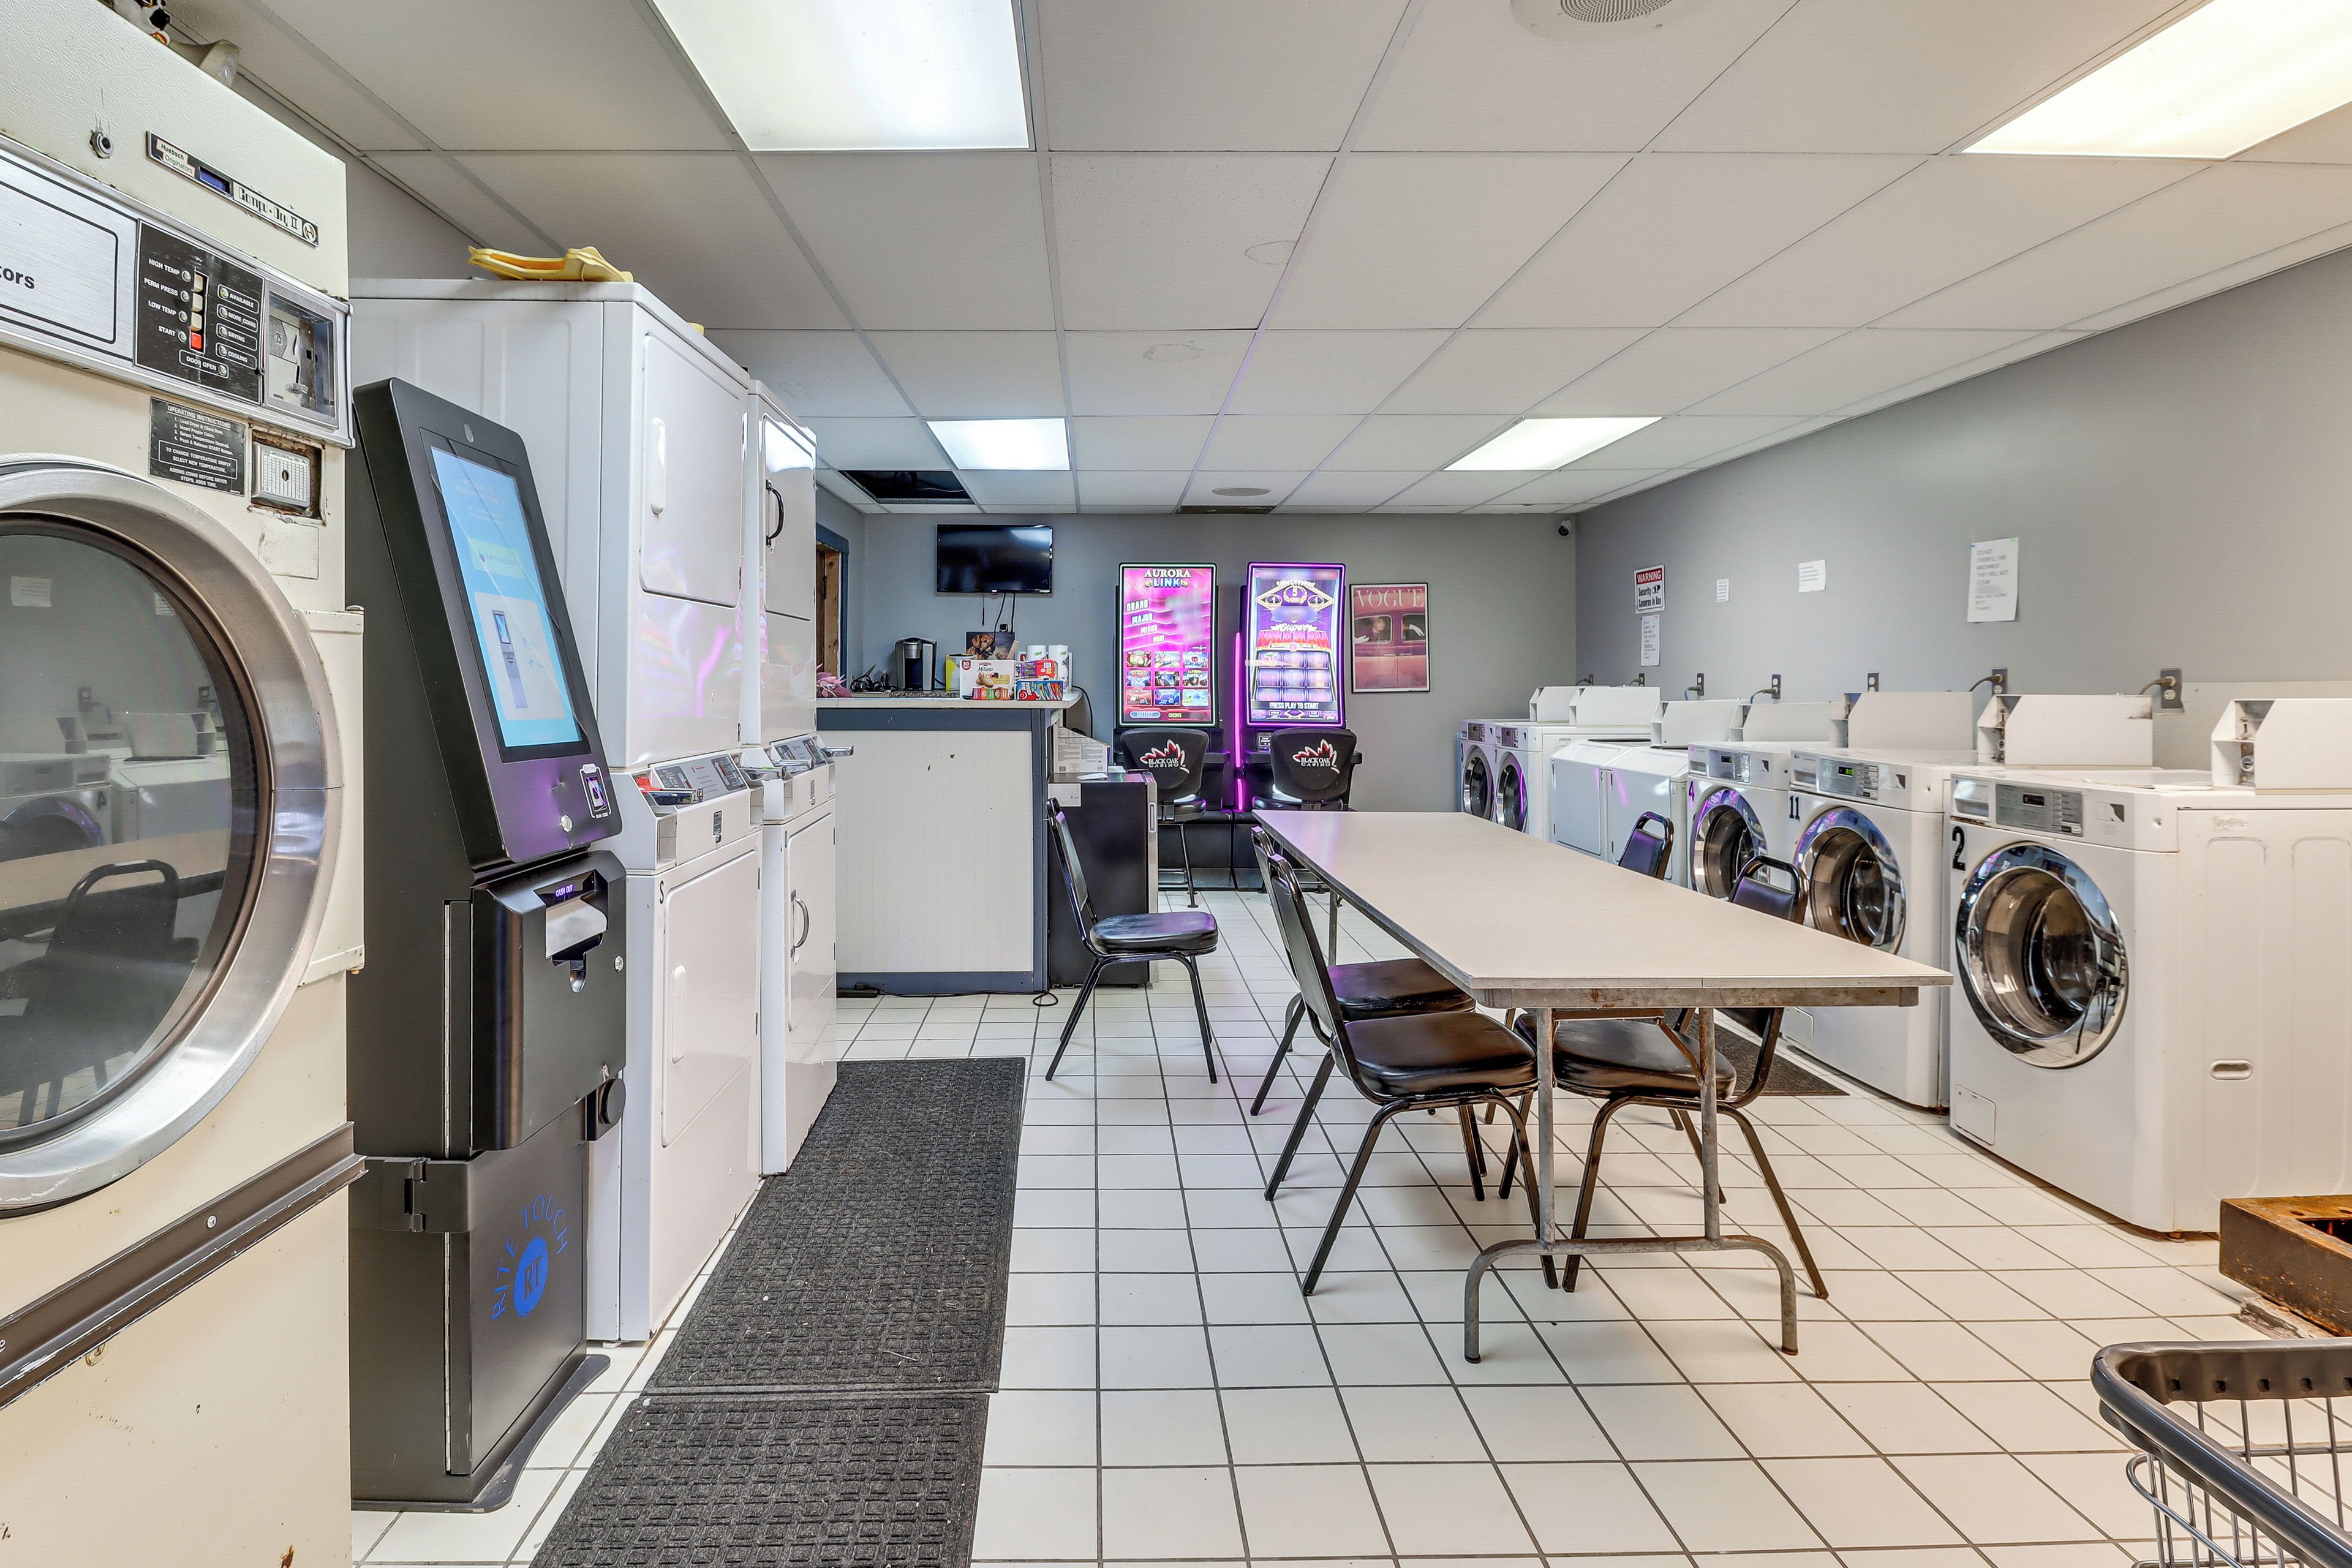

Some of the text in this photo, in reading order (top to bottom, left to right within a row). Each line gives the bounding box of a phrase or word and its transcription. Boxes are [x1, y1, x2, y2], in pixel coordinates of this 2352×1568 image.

[160, 143, 184, 160] Huebsch
[165, 155, 193, 175] Originators
[148, 258, 180, 275] HIGH TEMP
[144, 277, 178, 296] PERM PRESS
[148, 300, 176, 315] LOW TEMP
[229, 293, 254, 308] AVAILABLE
[228, 312, 256, 328] MORE COINS
[158, 326, 176, 337] START
[228, 331, 245, 342] DRYING
[186, 356, 217, 371] DOOR OPEN
[228, 350, 247, 363] COOLING
[167, 405, 231, 429] OPERATING INSTRUCTIONS
[190, 453, 217, 464] TEMPERATURE
[1144, 568, 1191, 578] AURORA
[1637, 570, 1661, 584] WARNING
[1153, 578, 1181, 588] LINK
[1292, 586, 1298, 597] 5
[1356, 589, 1424, 608] VOGUE
[1638, 587, 1651, 597] Security
[1638, 599, 1651, 608] Cameras
[1131, 612, 1153, 625] MAJOR
[1140, 624, 1158, 635] MINOR
[1688, 781, 1695, 801] 4
[1789, 795, 1800, 820] 11
[1951, 825, 1966, 872] 2
[556, 887, 565, 897] CASH
[492, 1194, 568, 1321] RITE TOUCH
[523, 1255, 541, 1300] RT
